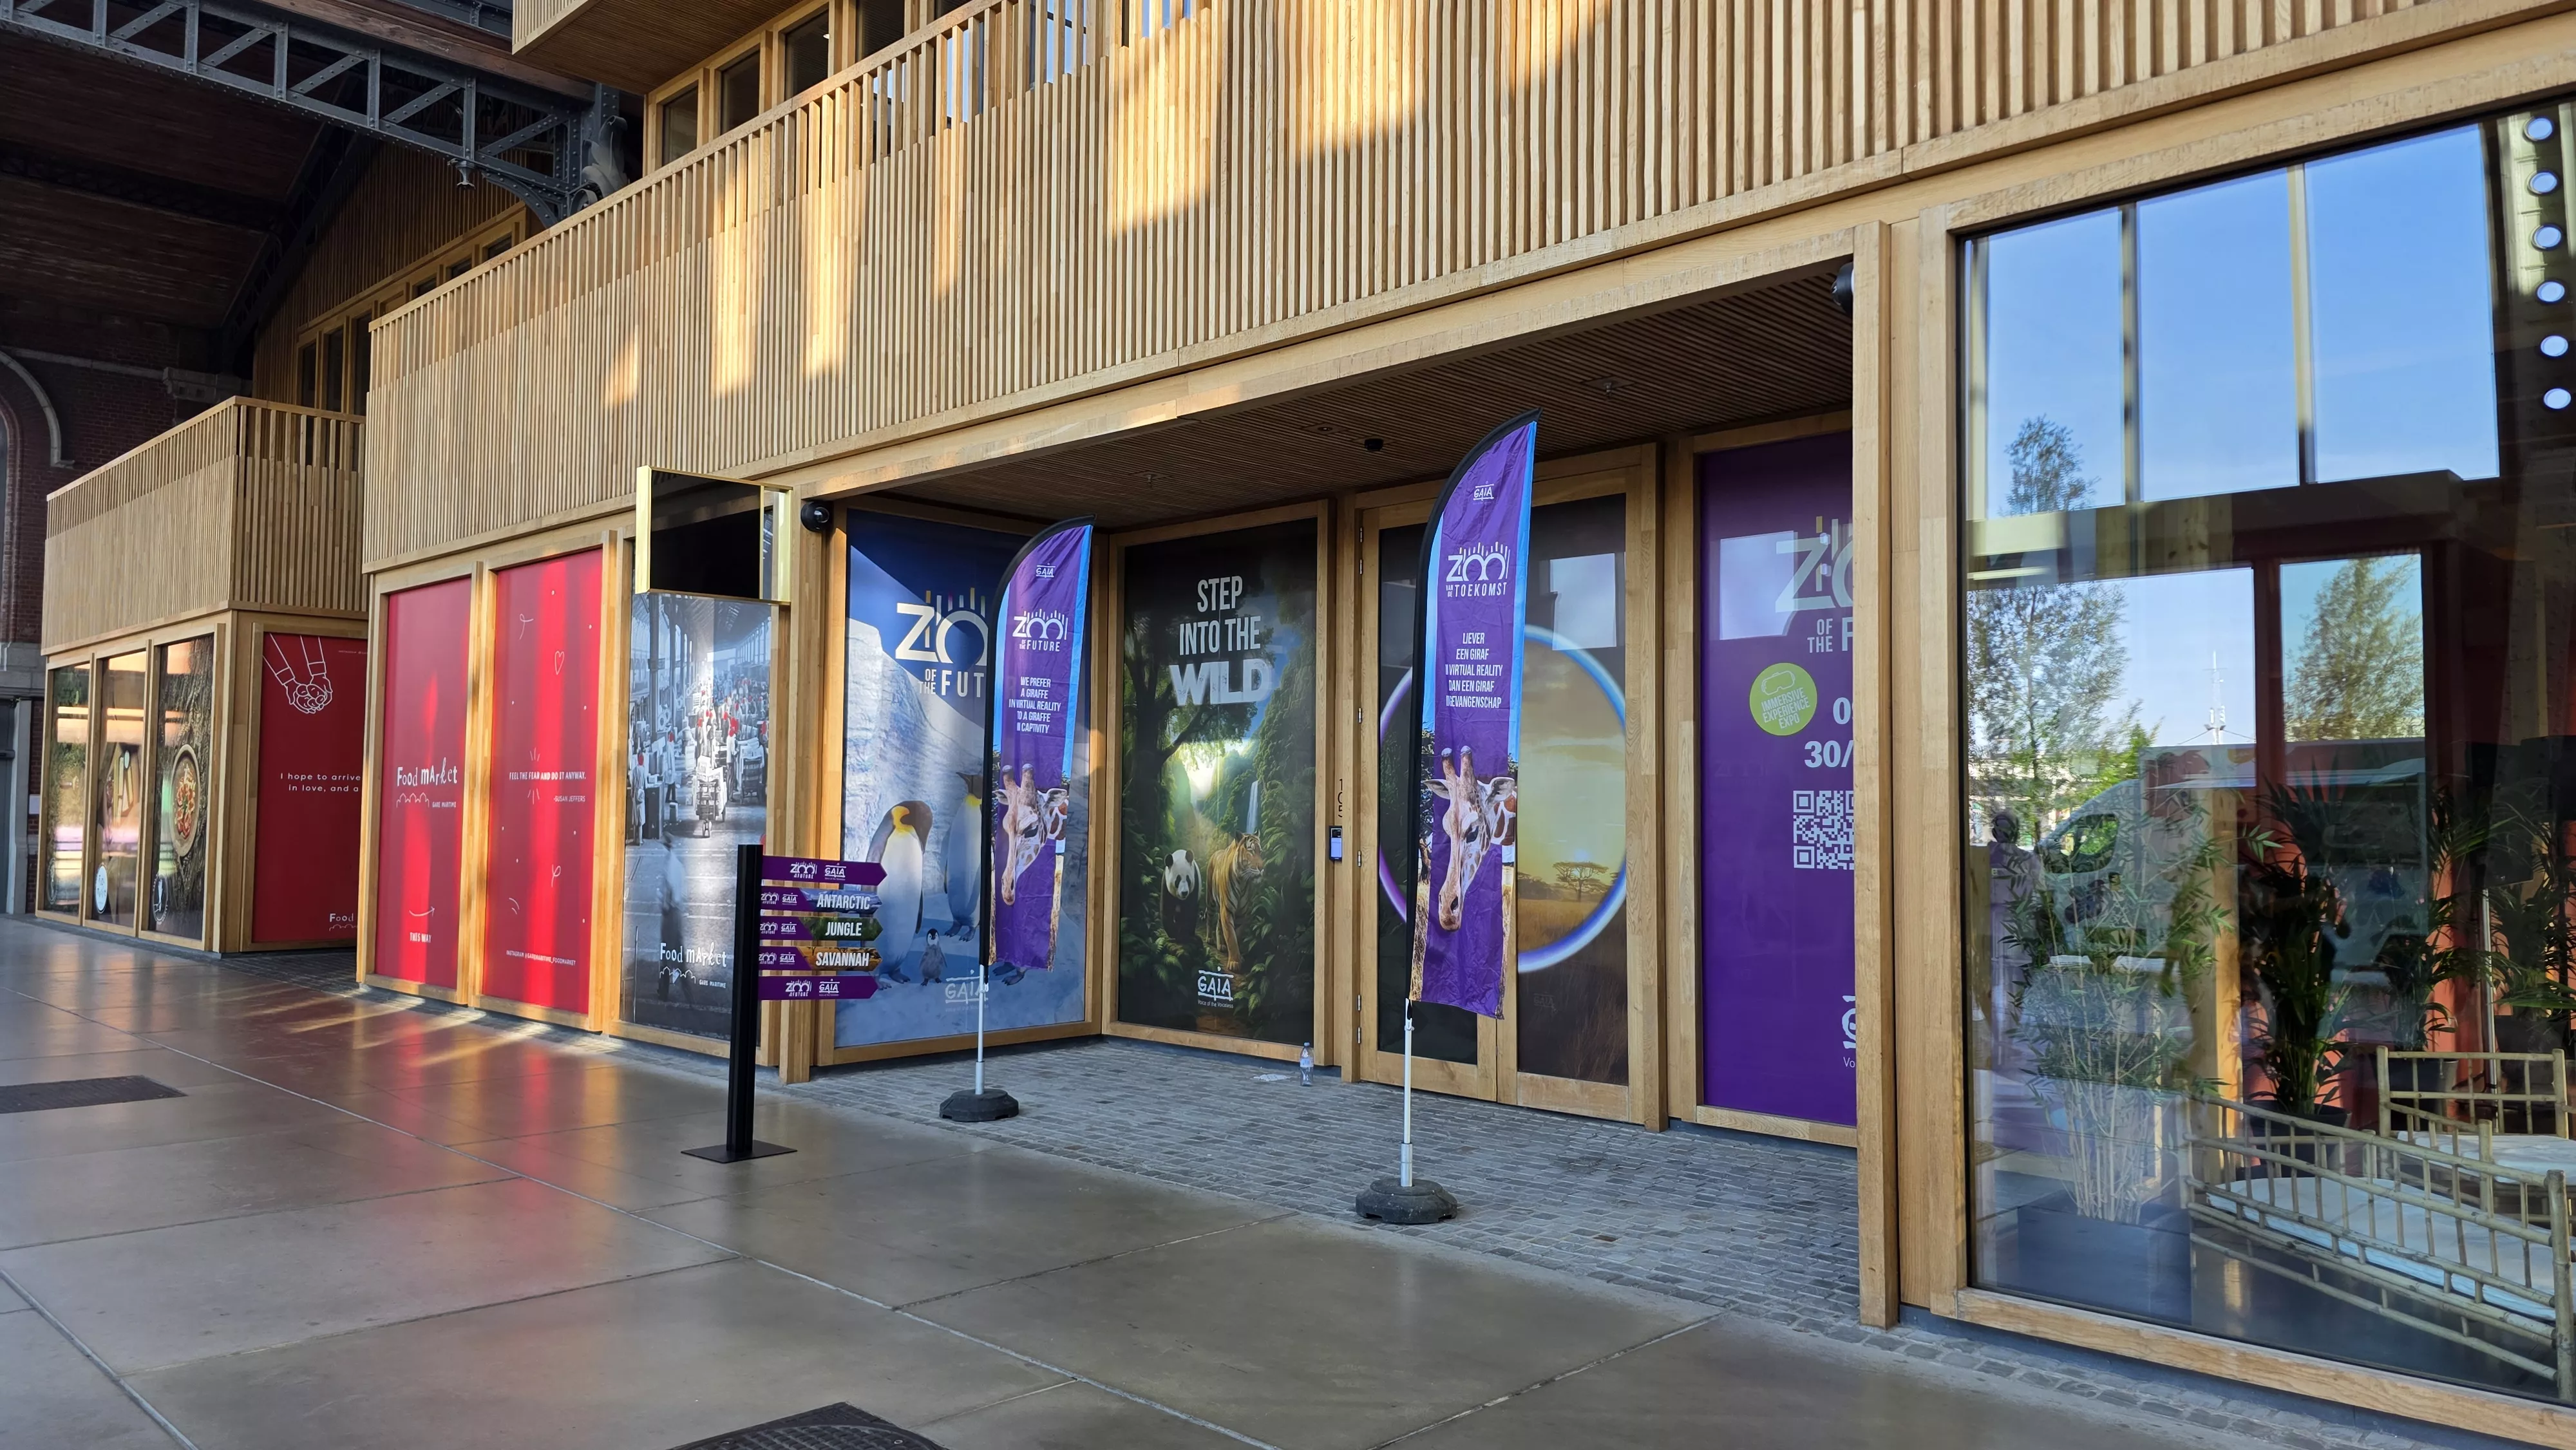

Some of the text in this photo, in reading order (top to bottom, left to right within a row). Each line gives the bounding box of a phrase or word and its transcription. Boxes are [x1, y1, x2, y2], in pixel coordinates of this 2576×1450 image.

[1473, 486, 1494, 501] GAIA
[1036, 567, 1054, 578] GAIA
[1446, 552, 1506, 581] ZOO
[1197, 576, 1243, 612] STEP
[1455, 582, 1507, 598] TOEKOMST
[1817, 618, 1833, 636] OF
[895, 603, 989, 666] ZO
[1179, 616, 1261, 656] INTO THE
[1463, 632, 1485, 645] LIEVER
[1027, 639, 1061, 652] FUTURE
[1807, 636, 1833, 653] THE
[1455, 648, 1490, 660] EEN GIRAF
[925, 668, 937, 681] OF
[1449, 664, 1475, 676] VIRTUAL
[1476, 664, 1503, 677] REALITY
[918, 670, 985, 698] THE FUT
[1020, 676, 1051, 688] WE PREFER
[1169, 658, 1274, 706] WILD
[1448, 679, 1495, 693] DAN EEN GIRAF
[1020, 688, 1025, 697] A
[1761, 687, 1806, 712] IMMERSIVE
[1037, 701, 1061, 712] REALITY
[1762, 697, 1811, 723] EXPERIENCE
[1023, 711, 1028, 720] A
[1778, 713, 1800, 729] EXPO
[1021, 722, 1050, 733] CAPTIVITY
[288, 773, 313, 782] hope
[397, 766, 418, 787] Food
[509, 772, 520, 780] FEEL
[529, 771, 540, 780] FEAR
[540, 772, 551, 780] AND
[551, 772, 559, 780] DO
[559, 771, 565, 780] IT
[565, 771, 587, 780] ANYWAY.
[825, 867, 845, 878] GAIA
[817, 894, 871, 910] ANTARCTIC
[329, 912, 354, 923] Food
[825, 922, 862, 936] JUNGLE
[410, 932, 421, 942] THIS
[660, 943, 683, 963] Food
[816, 952, 869, 966] SAVANNAH
[819, 984, 838, 993] GAIA
[1198, 976, 1233, 1001] GAIA
